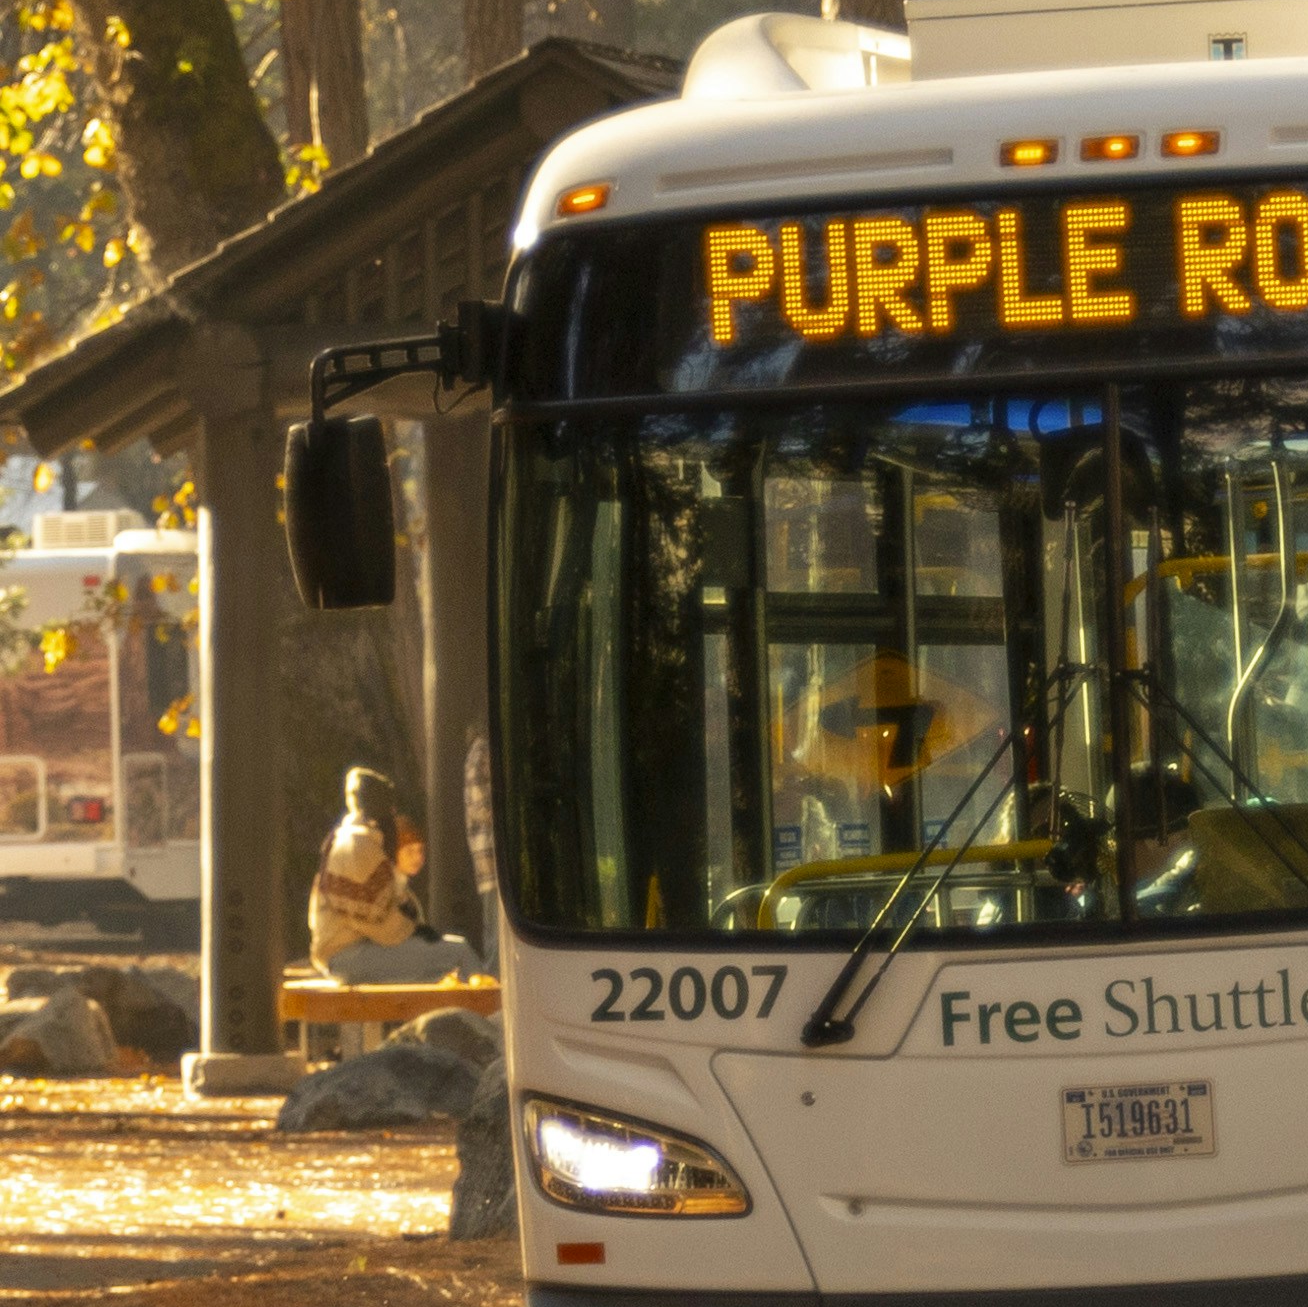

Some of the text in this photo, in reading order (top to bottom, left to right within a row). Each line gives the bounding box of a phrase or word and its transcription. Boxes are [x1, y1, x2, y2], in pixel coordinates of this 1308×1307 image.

[706, 204, 1132, 343] PURPLE
[590, 964, 789, 1023] 22007
[940, 991, 1084, 1047] Free
